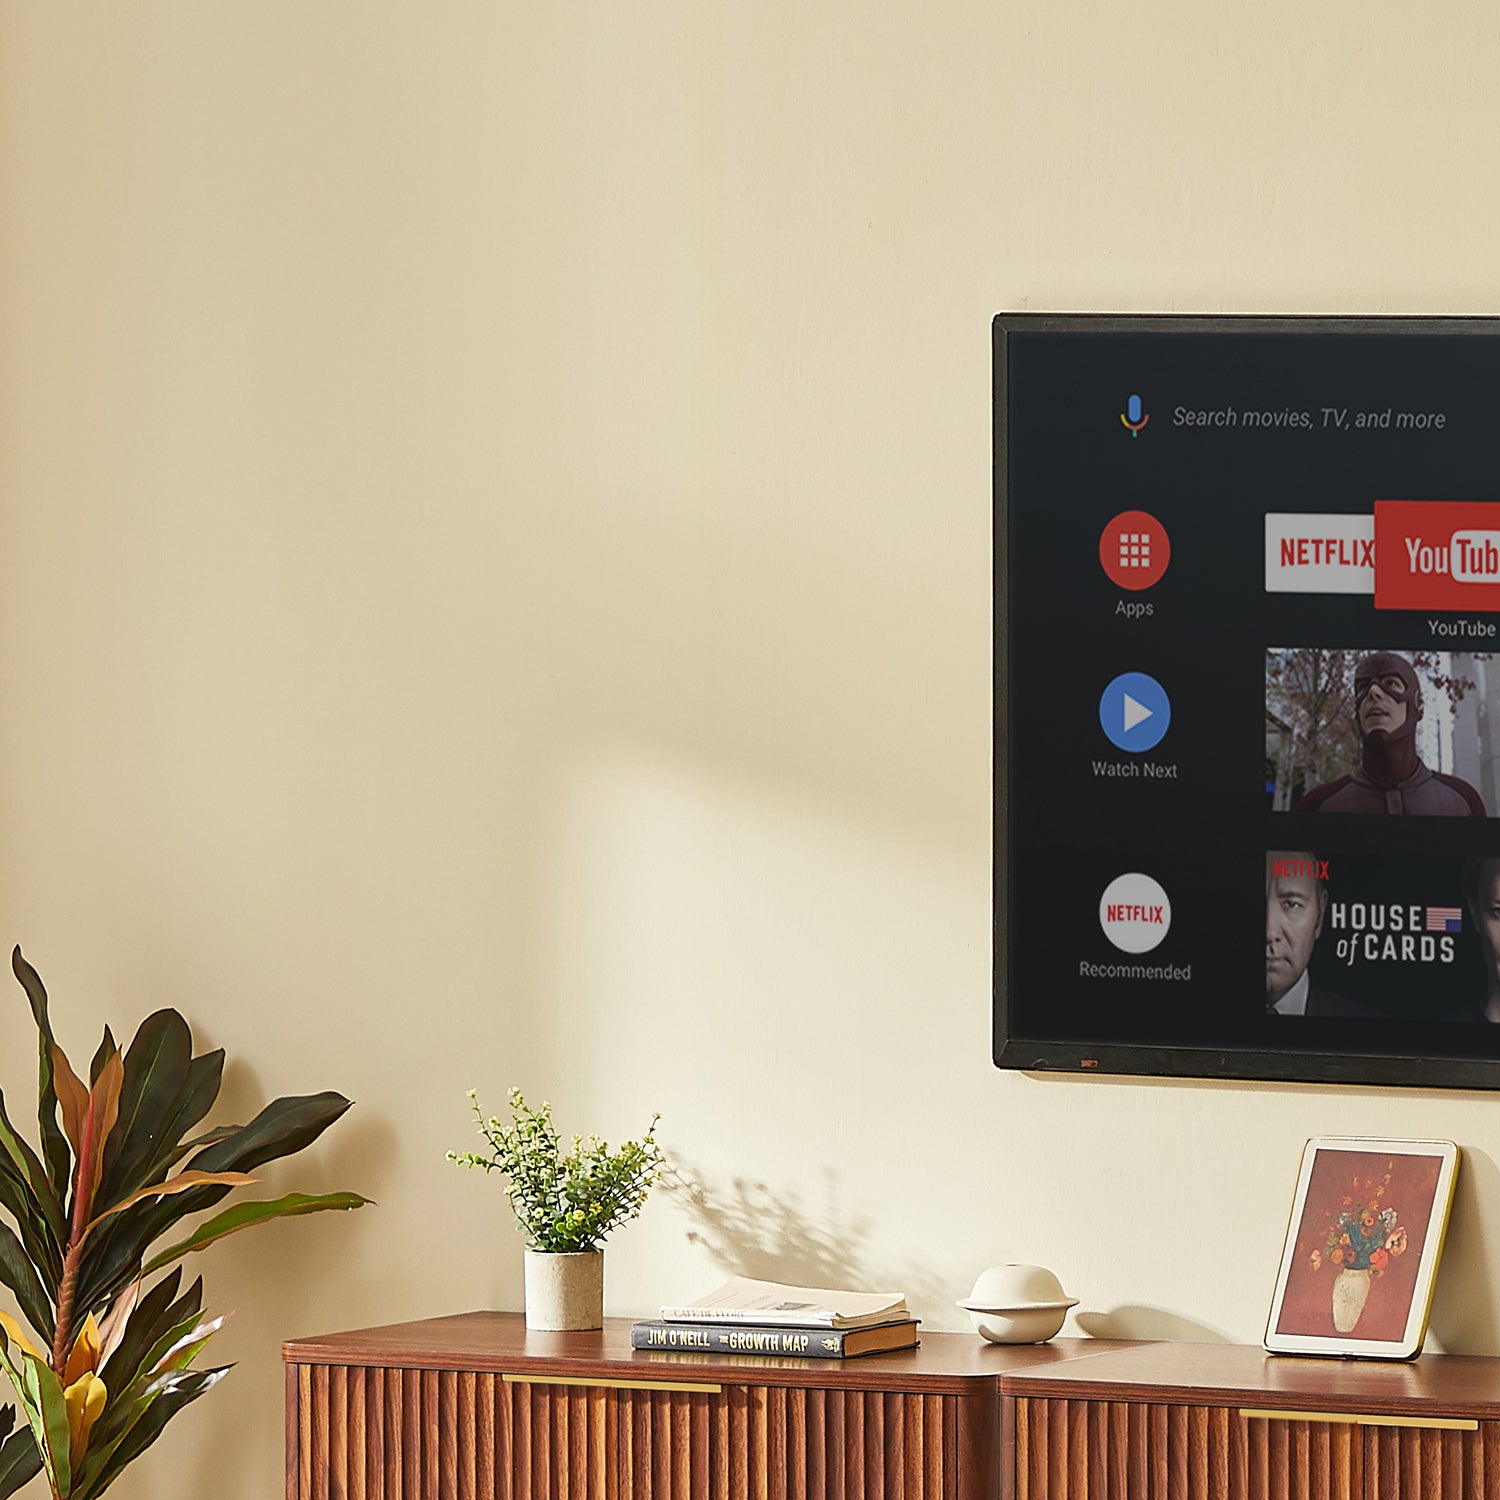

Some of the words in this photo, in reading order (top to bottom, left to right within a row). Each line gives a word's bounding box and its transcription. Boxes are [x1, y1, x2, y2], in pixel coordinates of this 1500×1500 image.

[1172, 406, 1237, 427] Search
[1242, 408, 1314, 430] movies,
[1320, 408, 1350, 430] TV,
[1355, 408, 1392, 428] and
[1396, 411, 1446, 429] more
[1280, 538, 1375, 569] NETFLIX
[1115, 600, 1154, 619] Apps
[1427, 620, 1497, 638] YouTube
[1091, 761, 1140, 777] Watch
[1143, 762, 1178, 778] Next
[1272, 860, 1330, 881] NETFLIX
[1107, 904, 1163, 924] NETFLIX
[1331, 903, 1422, 931] HOUSE
[1336, 932, 1360, 966] of
[1364, 933, 1455, 963] CARDS
[1080, 961, 1191, 980] Recommended
[647, 1328, 667, 1345] JIM
[669, 1330, 711, 1347] O'NEILL
[729, 1331, 779, 1350] GROWTH
[782, 1334, 809, 1352] MAP
